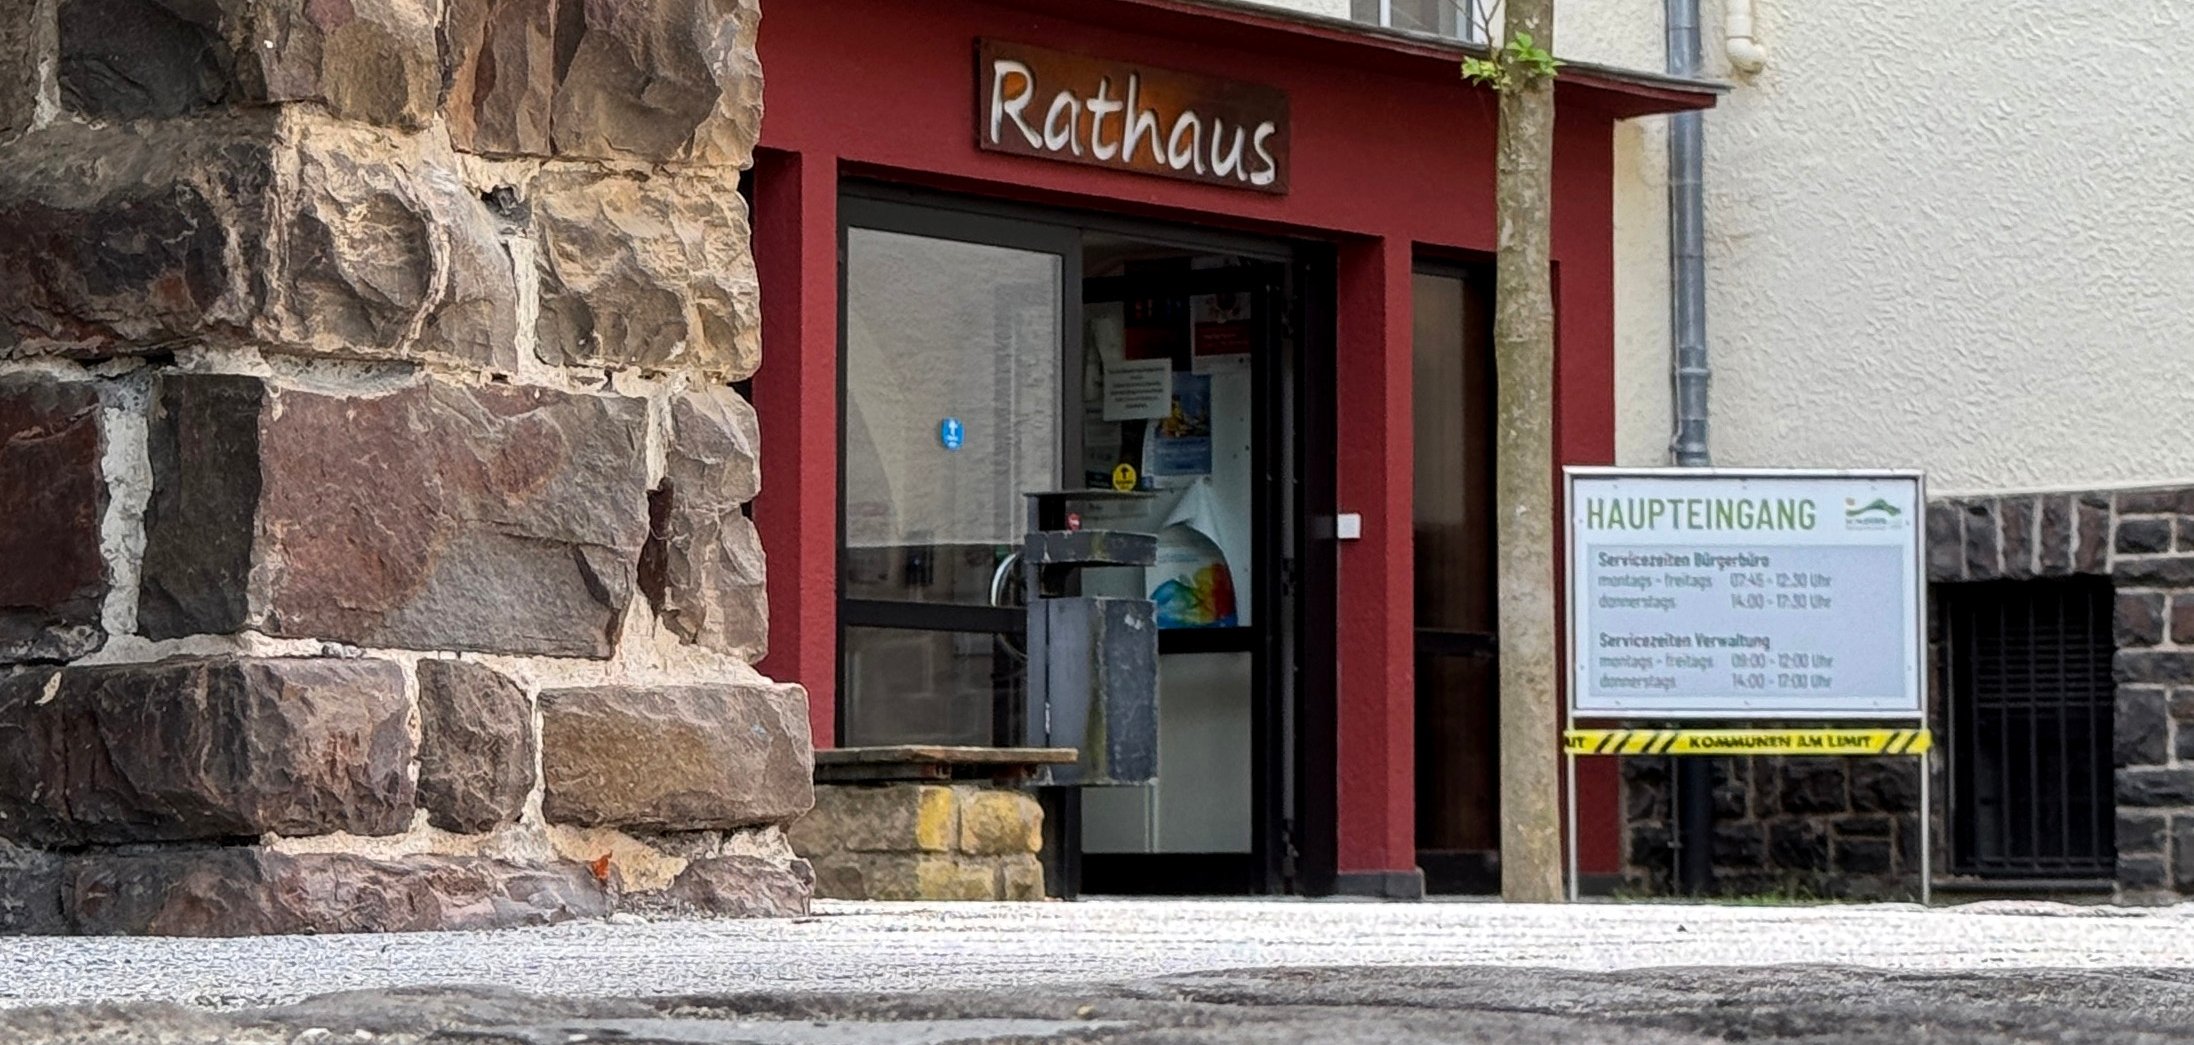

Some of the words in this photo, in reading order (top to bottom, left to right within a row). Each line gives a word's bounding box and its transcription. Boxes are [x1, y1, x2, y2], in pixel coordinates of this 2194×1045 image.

[991, 60, 1276, 186] Rathaus
[1586, 498, 1817, 530] HAUPTEINGANG
[1598, 551, 1690, 567] Servicezeiten
[1694, 551, 1770, 571] Bürgerbüro
[1598, 574, 1653, 591] montags
[1664, 572, 1713, 591] freitags
[1809, 572, 1832, 588] Uhr
[1598, 593, 1676, 612] donnerstags
[1809, 593, 1832, 609] Uhr
[1599, 632, 1692, 648] Servicezeiten
[1694, 632, 1770, 652] Verwaltung
[1599, 655, 1654, 671] montags
[1665, 653, 1714, 672] freitags
[1811, 653, 1834, 669] Uhr
[1599, 673, 1677, 692] donnerstags
[1810, 673, 1833, 689] Uhr
[1689, 736, 1792, 748] KOMMUNEN
[1797, 736, 1824, 748] AM
[1828, 736, 1872, 748] LIMIT
